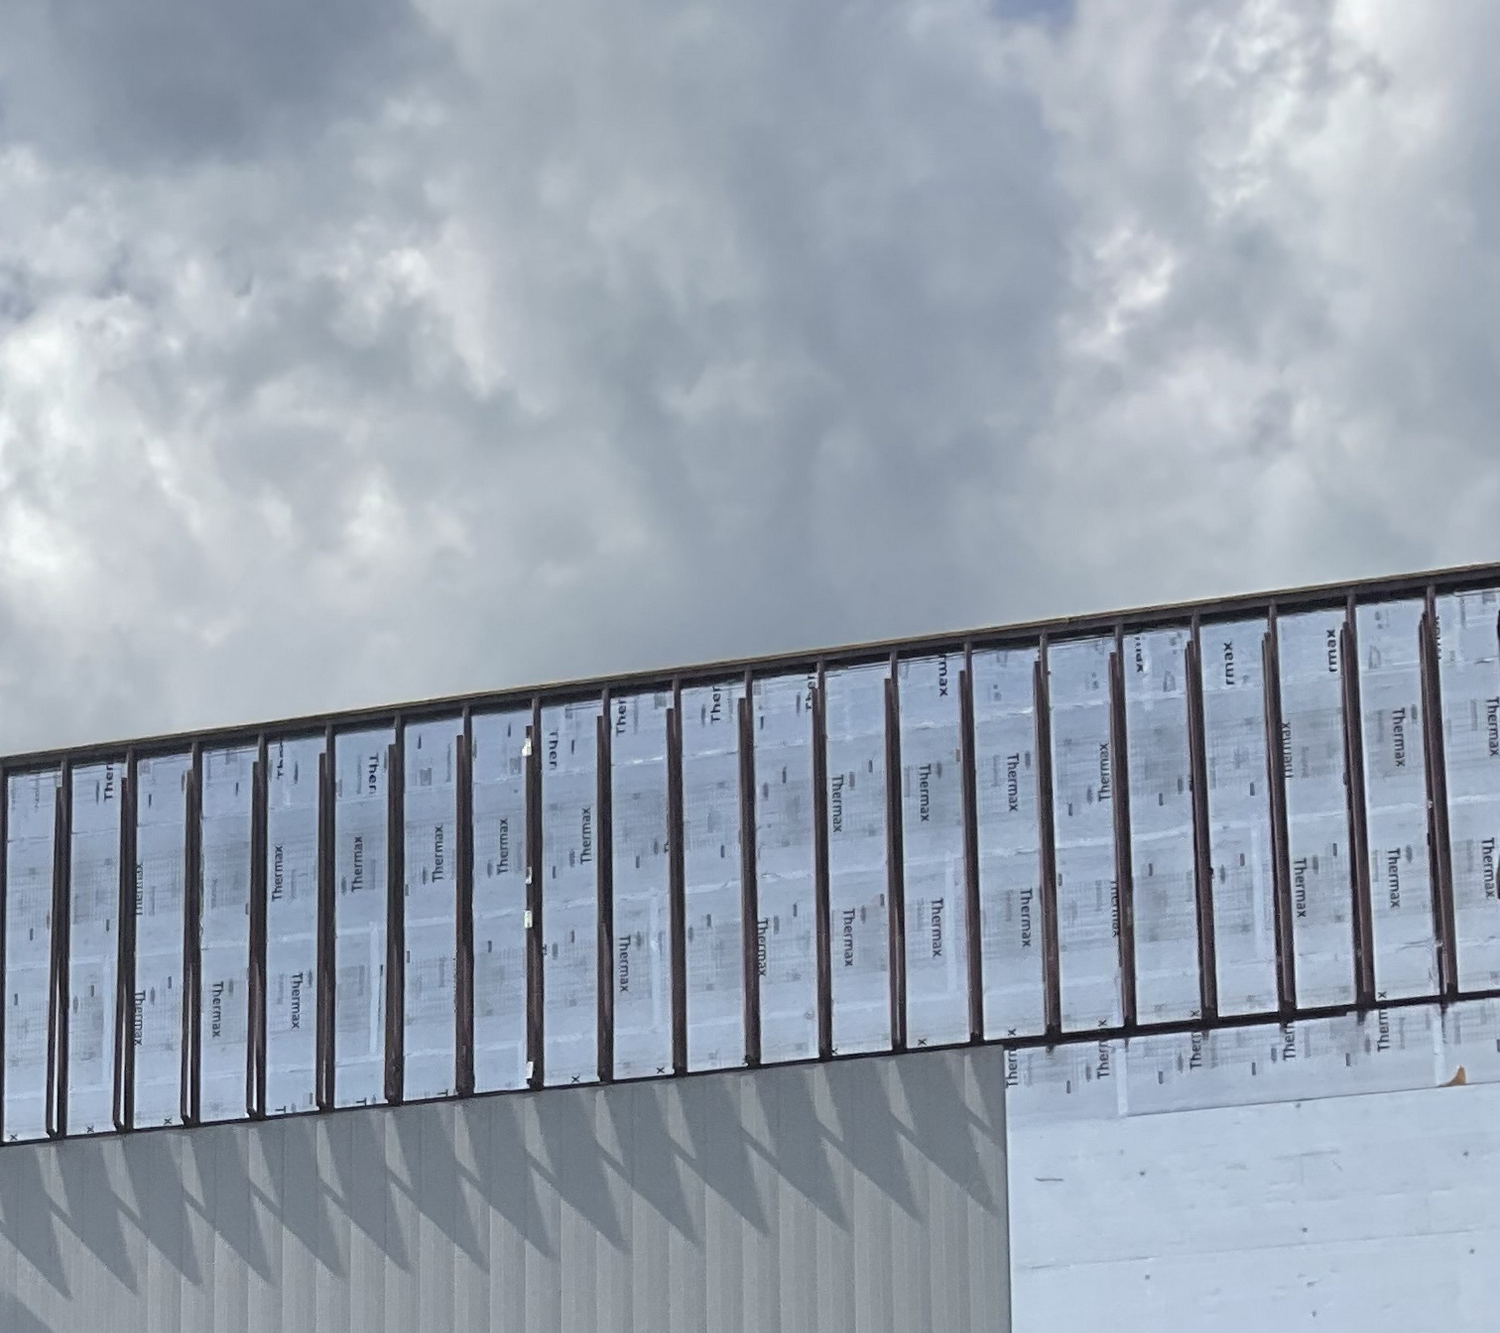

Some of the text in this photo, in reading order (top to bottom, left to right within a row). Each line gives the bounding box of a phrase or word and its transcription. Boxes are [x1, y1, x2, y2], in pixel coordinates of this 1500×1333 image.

[1392, 707, 1406, 767] Thermax
[1486, 696, 1499, 757] Thermax
[919, 763, 931, 822] Thermax
[1007, 752, 1020, 812] Thermax
[1098, 742, 1110, 802] Thermax
[832, 774, 844, 833] Thermax
[351, 836, 363, 893] Thermax
[432, 825, 444, 883] Thermax
[497, 818, 509, 875] Thermax
[580, 807, 592, 864] Thermax
[271, 845, 283, 901] Thermax
[1294, 857, 1308, 918] Thermax
[1388, 847, 1401, 908] Thermax
[1482, 837, 1495, 898] Thermax
[757, 917, 769, 976] Thermax
[843, 908, 855, 967] Thermax
[931, 897, 944, 957] Thermax
[1020, 888, 1033, 947] Thermax
[619, 935, 631, 993] Thermax
[134, 989, 146, 1046] Thermax
[211, 981, 224, 1038] Thermax
[290, 971, 303, 1029] Thermax
